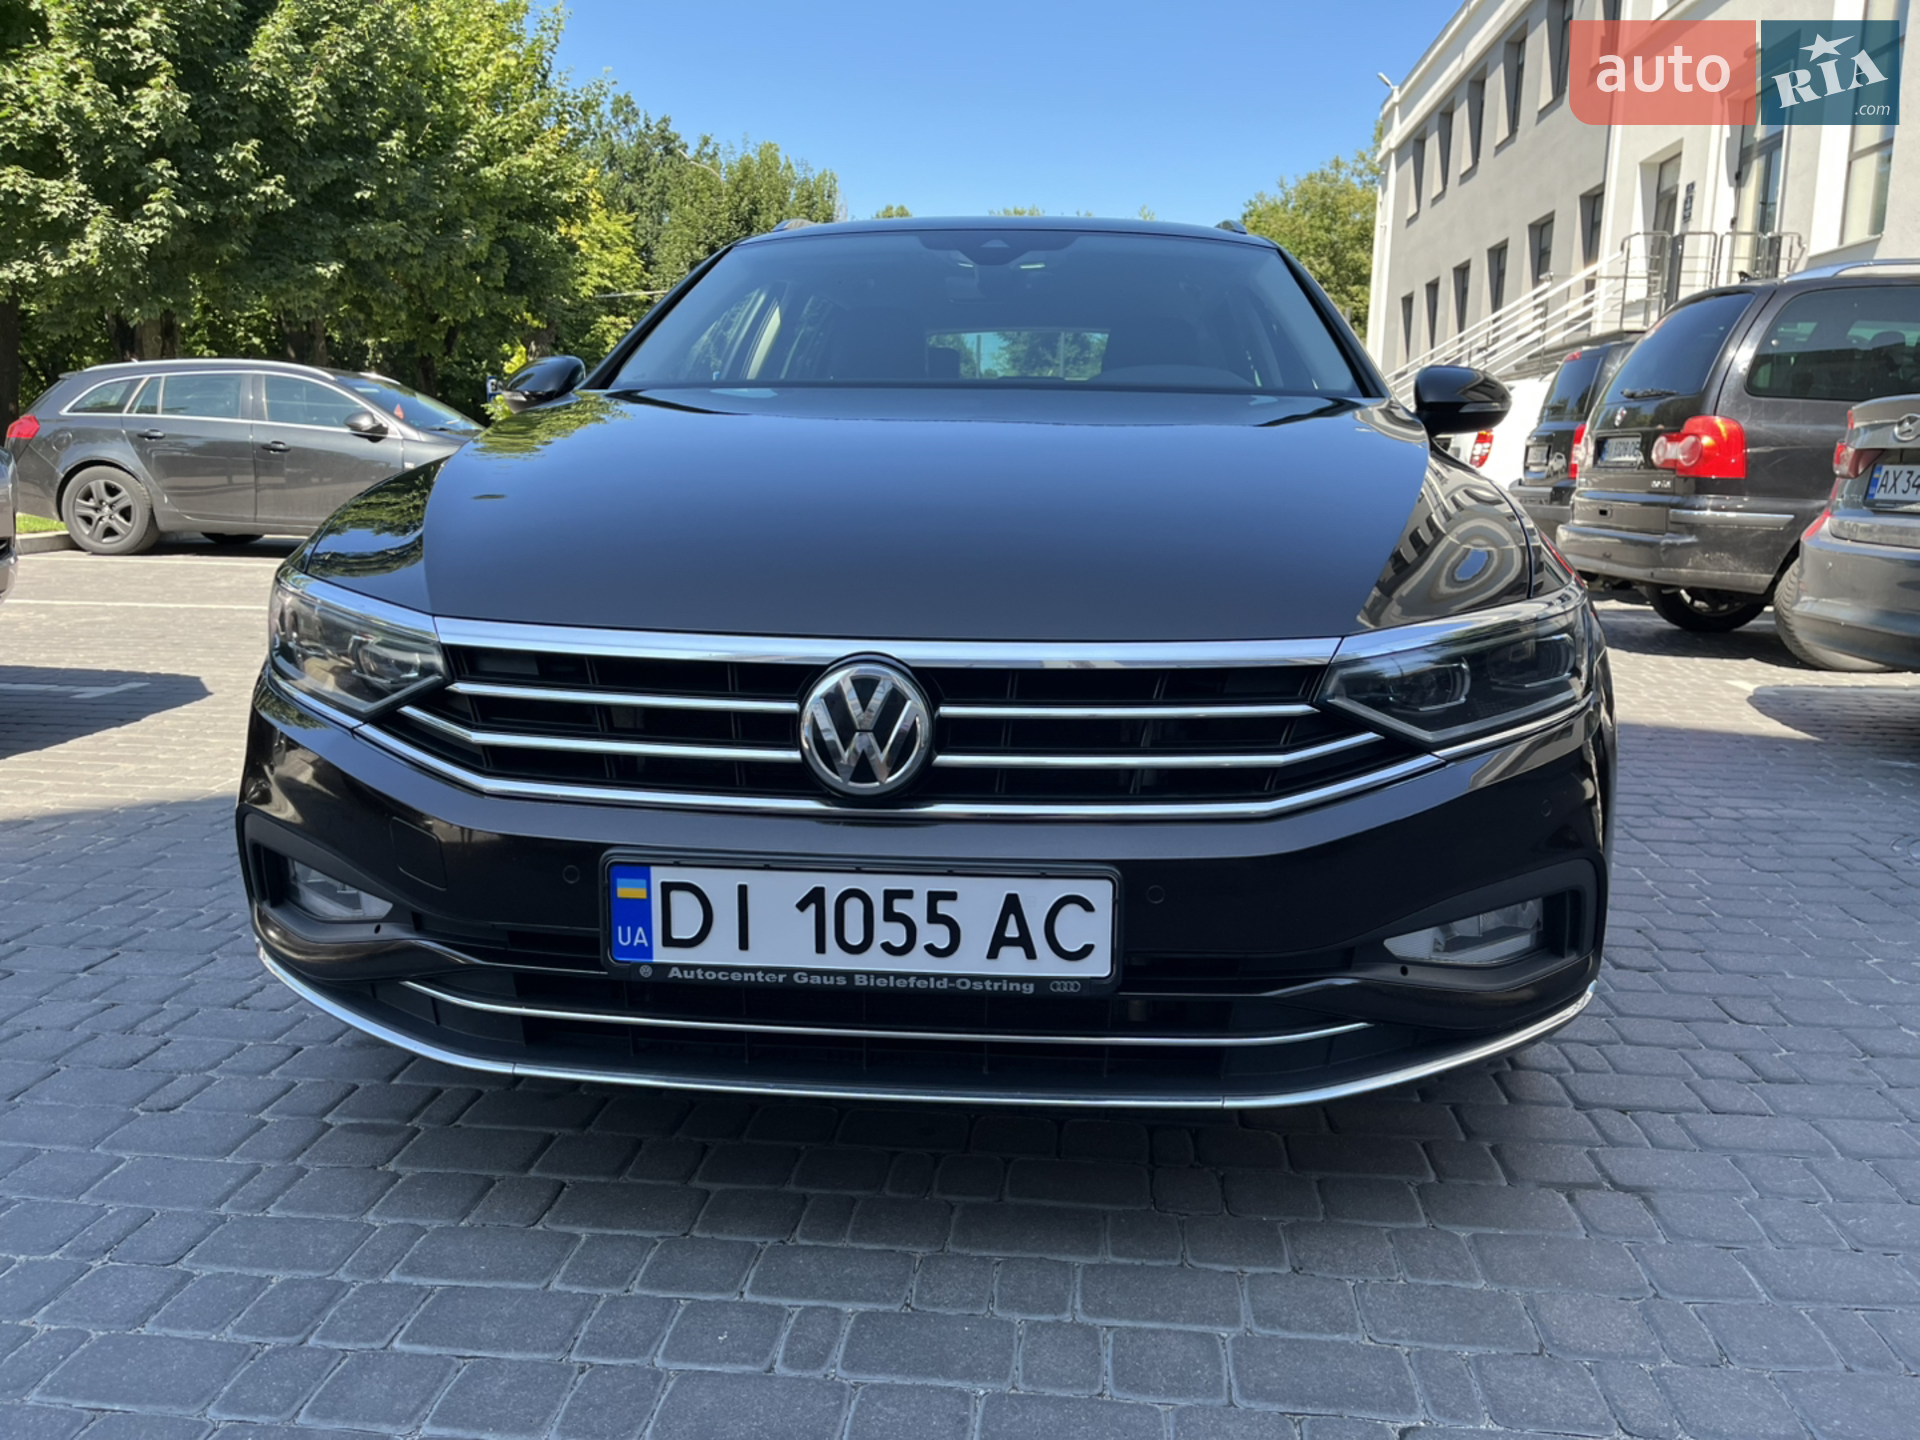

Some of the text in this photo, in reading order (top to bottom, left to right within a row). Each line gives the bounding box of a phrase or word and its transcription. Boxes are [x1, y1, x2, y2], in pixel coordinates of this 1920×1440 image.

[1877, 469, 1903, 495] AX
[660, 880, 1096, 962] DI 1055 AC
[617, 925, 649, 948] UA
[667, 965, 1036, 995] Autocenter Gaus Bielefeld-Ostring
